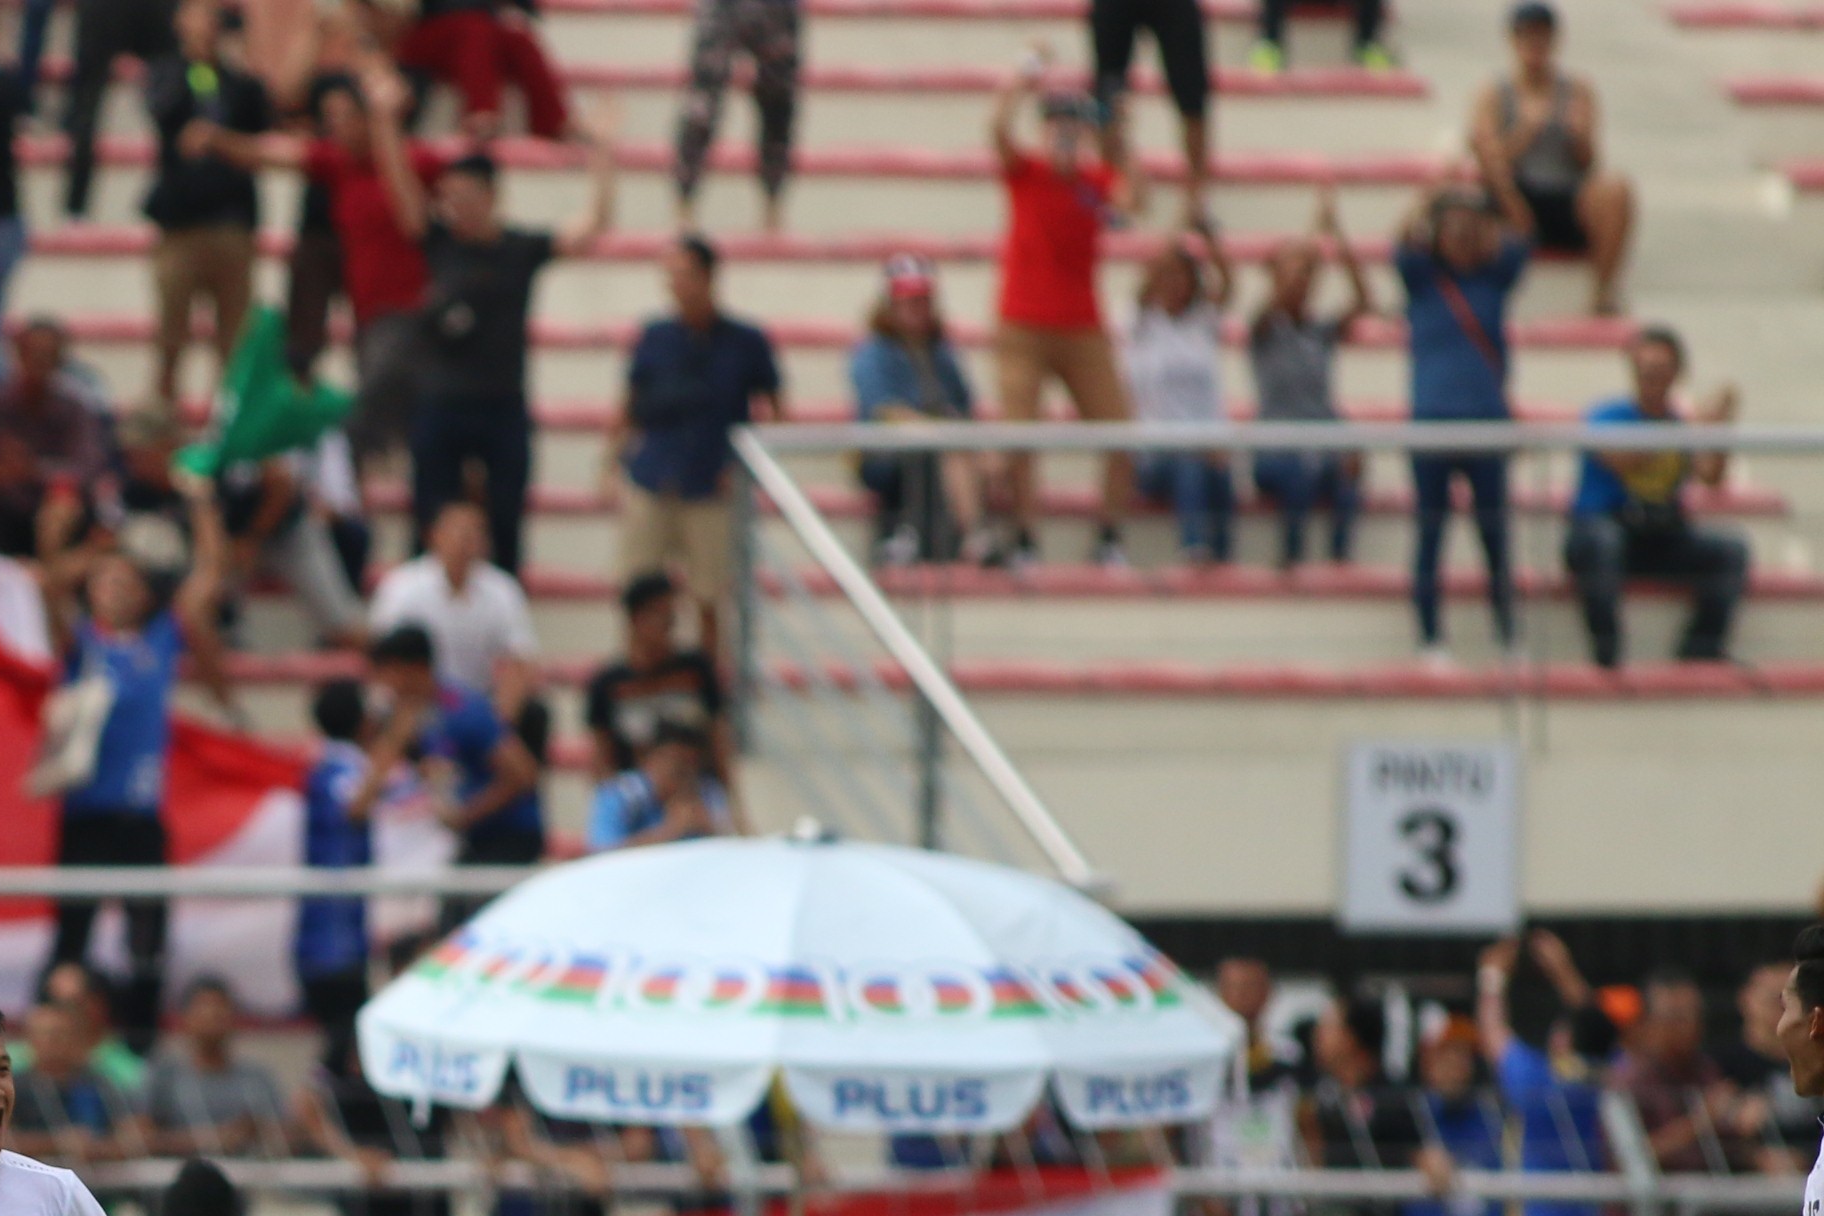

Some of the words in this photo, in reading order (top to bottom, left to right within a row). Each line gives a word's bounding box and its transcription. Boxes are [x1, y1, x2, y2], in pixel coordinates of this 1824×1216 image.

[1398, 808, 1458, 905] 3
[566, 1066, 714, 1111] PLUS
[832, 1077, 991, 1121] PLUS
[1085, 1069, 1193, 1113] PLUS
